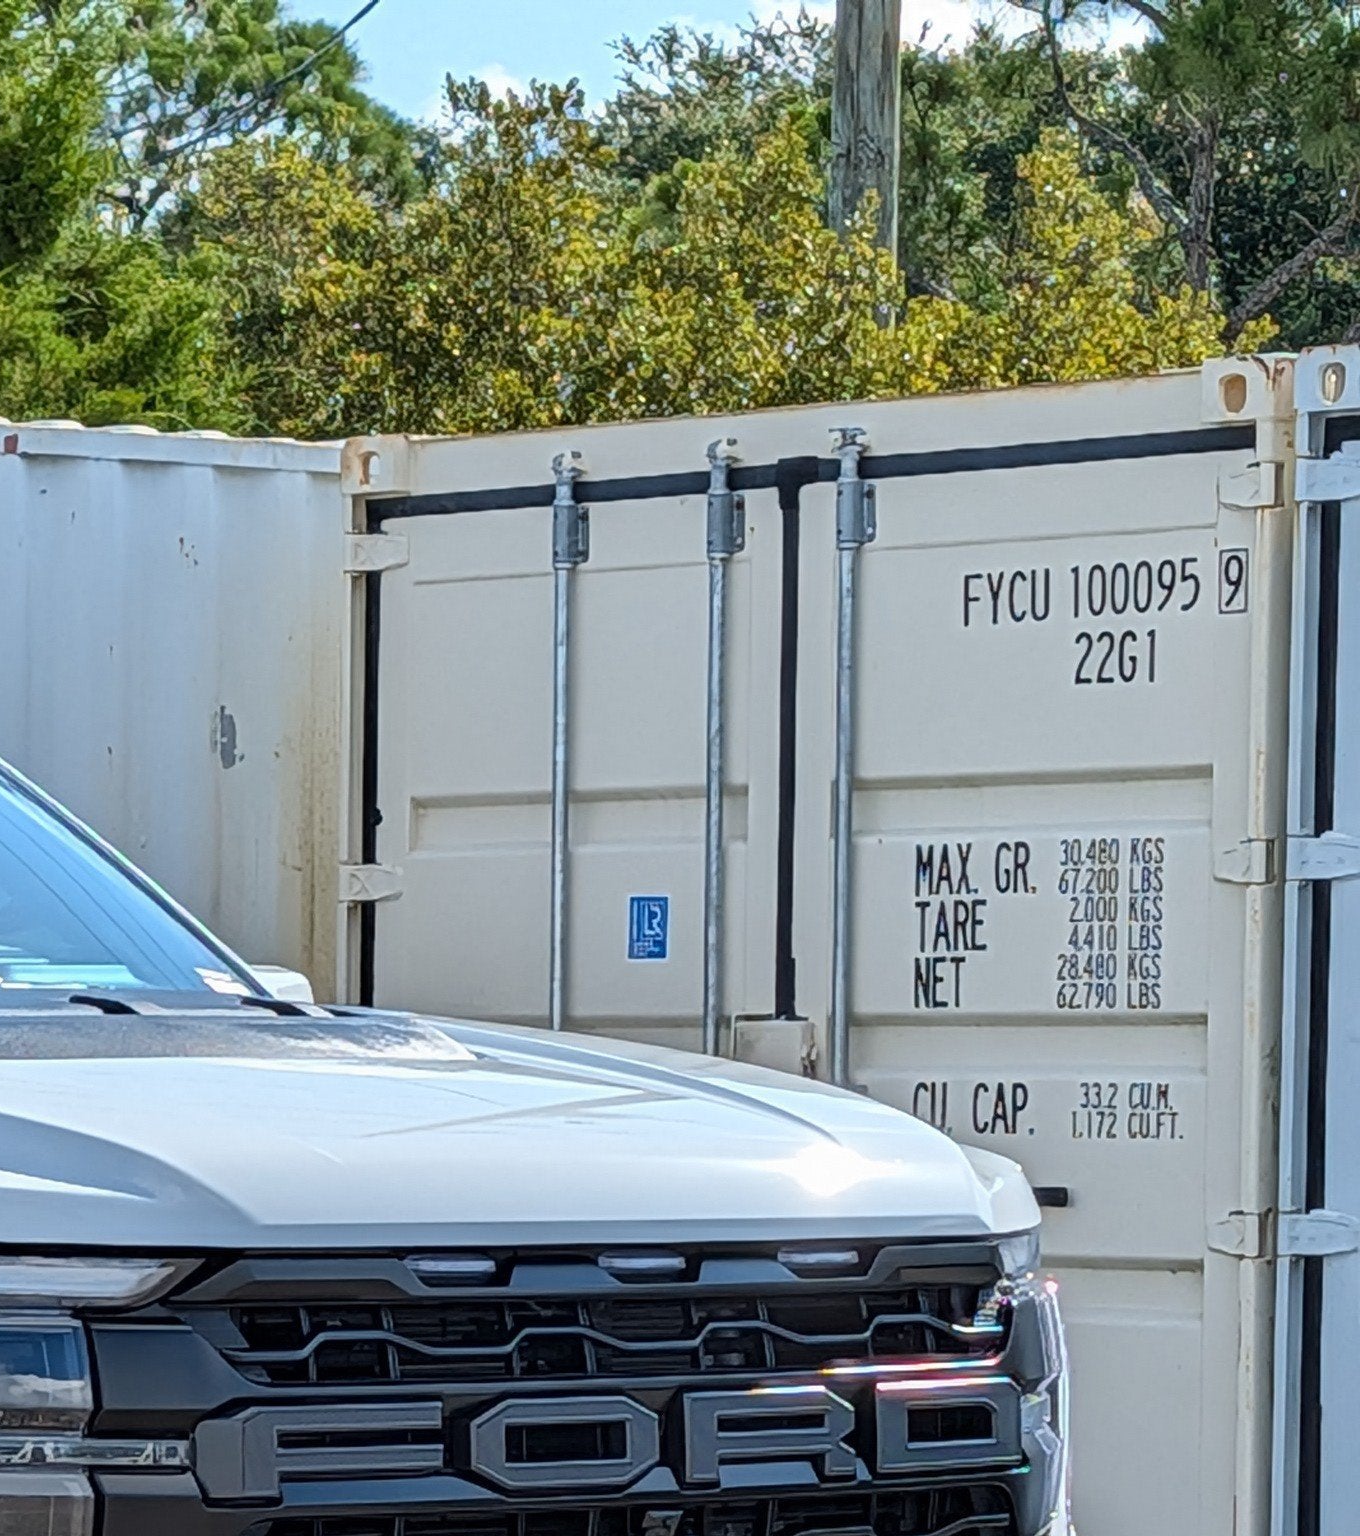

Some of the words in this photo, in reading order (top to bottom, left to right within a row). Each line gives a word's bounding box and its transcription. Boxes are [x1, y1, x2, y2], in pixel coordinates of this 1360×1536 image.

[963, 566, 1050, 627] FYCU
[1070, 557, 1201, 619] 100095
[1223, 554, 1244, 608] 9
[1074, 628, 1156, 685] 22G1
[914, 842, 979, 897] MAX.
[994, 841, 1037, 894] GR.
[1129, 837, 1165, 864] KGS
[1128, 866, 1164, 894] LBS
[914, 899, 988, 952] TARE
[1128, 896, 1163, 923] KGS
[1127, 924, 1163, 951] LBS
[913, 956, 966, 1009] NET
[1127, 953, 1162, 981] KGS
[1126, 982, 1162, 1010] LBS
[972, 1082, 1035, 1135] CAP.
[196, 1377, 1024, 1500] FORD
